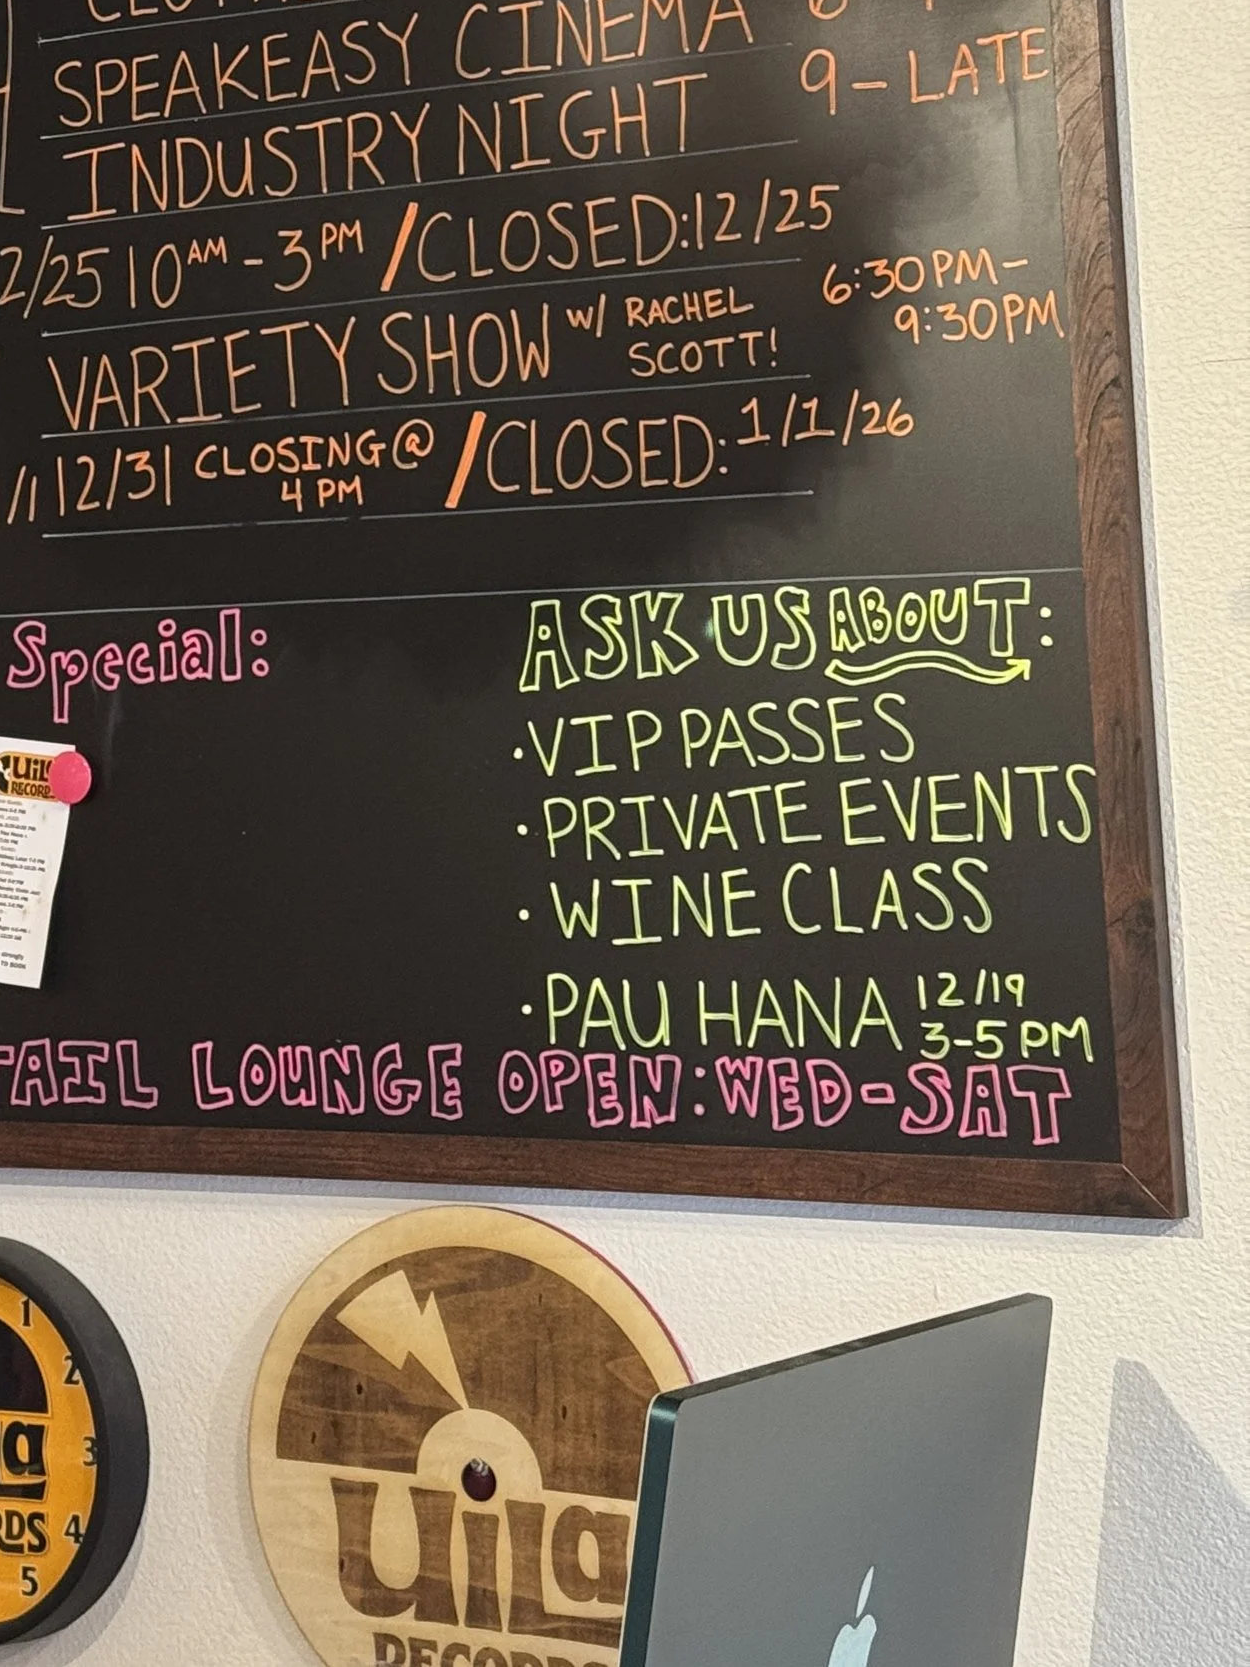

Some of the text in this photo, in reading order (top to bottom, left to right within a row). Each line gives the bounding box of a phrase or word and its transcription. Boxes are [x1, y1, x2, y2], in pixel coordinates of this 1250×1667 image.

[54, 13, 419, 127] SPEAKEASY
[62, 102, 431, 220] INDUSTRY
[457, 73, 708, 175] NIGHT
[49, 316, 356, 431] VARIETY
[377, 303, 549, 396] SHOW
[626, 286, 754, 327] RACHEL
[628, 327, 777, 377] SCOTT!
[56, 445, 172, 516] 12/31
[7, 607, 270, 724] Special:
[519, 577, 1053, 692] ASK US ABOUT:
[527, 692, 915, 776] VIP PASSES
[543, 764, 1097, 861] PRIVATE EVENTS
[550, 858, 993, 946] WINE CLASS
[546, 972, 670, 1051] PAU
[698, 976, 903, 1052] HANA
[191, 1039, 463, 1121] LOUNGE
[20, 1297, 33, 1327] 1
[83, 1436, 98, 1466] 3
[64, 1514, 84, 1544] 4
[20, 1566, 39, 1596] 5
